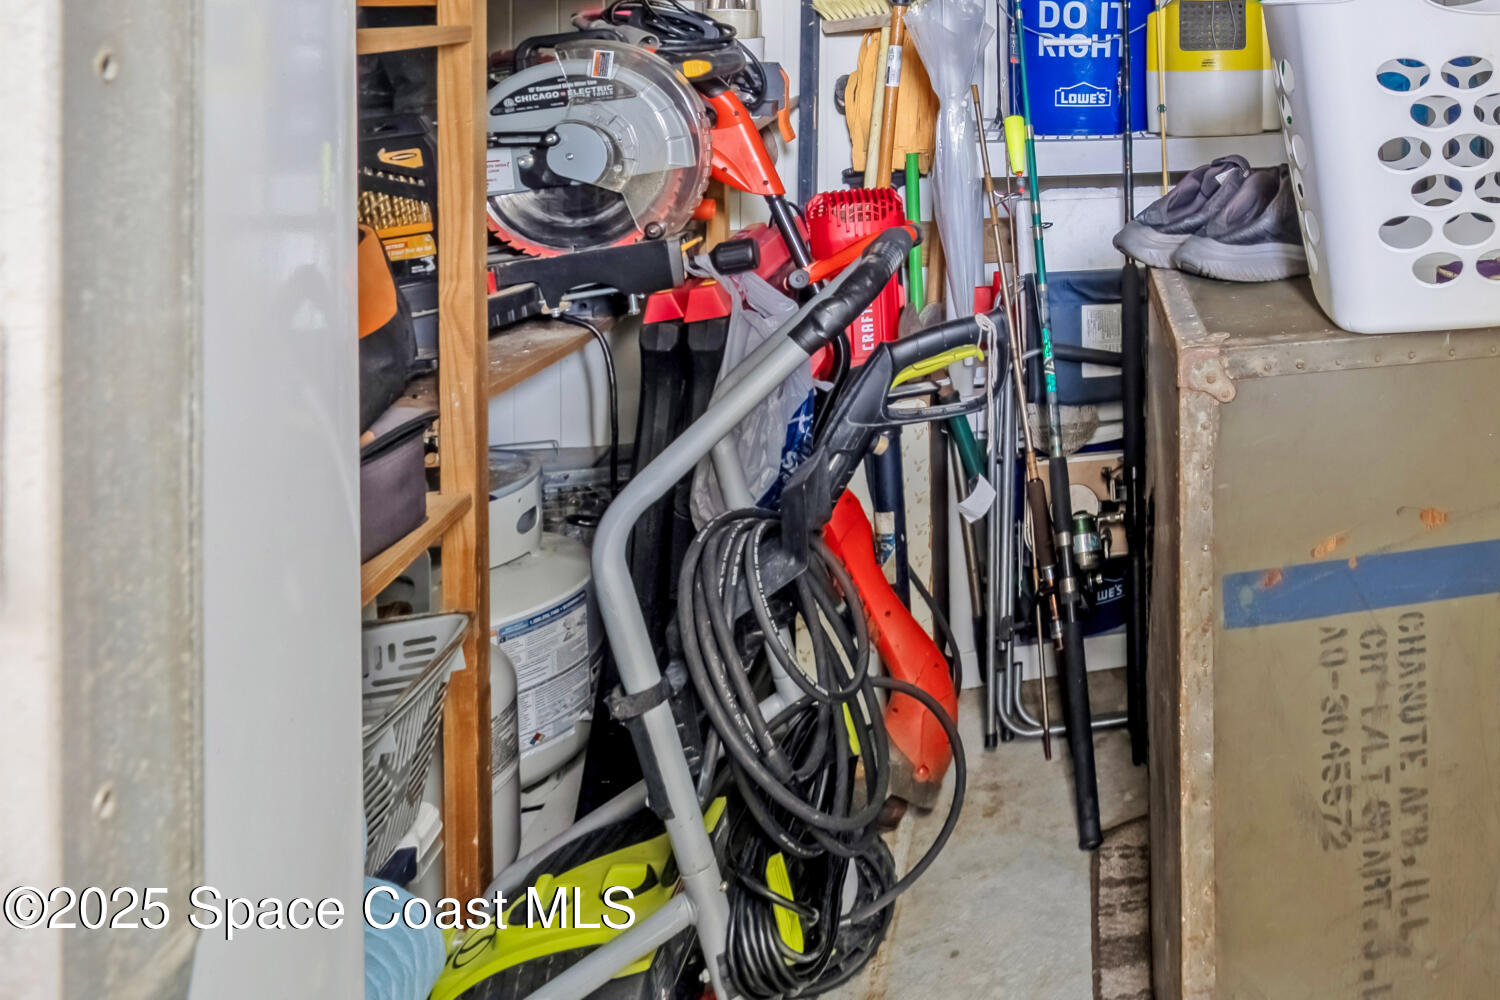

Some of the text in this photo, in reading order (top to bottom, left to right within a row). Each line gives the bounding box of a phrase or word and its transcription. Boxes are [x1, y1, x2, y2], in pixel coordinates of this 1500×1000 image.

[1038, 0, 1131, 30] DO IT
[1038, 32, 1124, 58] RIGHT
[514, 84, 614, 103] CHICAGO ELECTRIC
[1060, 91, 1106, 104] LOWE'S
[861, 302, 875, 351] CRAFT
[1096, 584, 1123, 602] WE'S
[1397, 610, 1429, 772] CHANUTE
